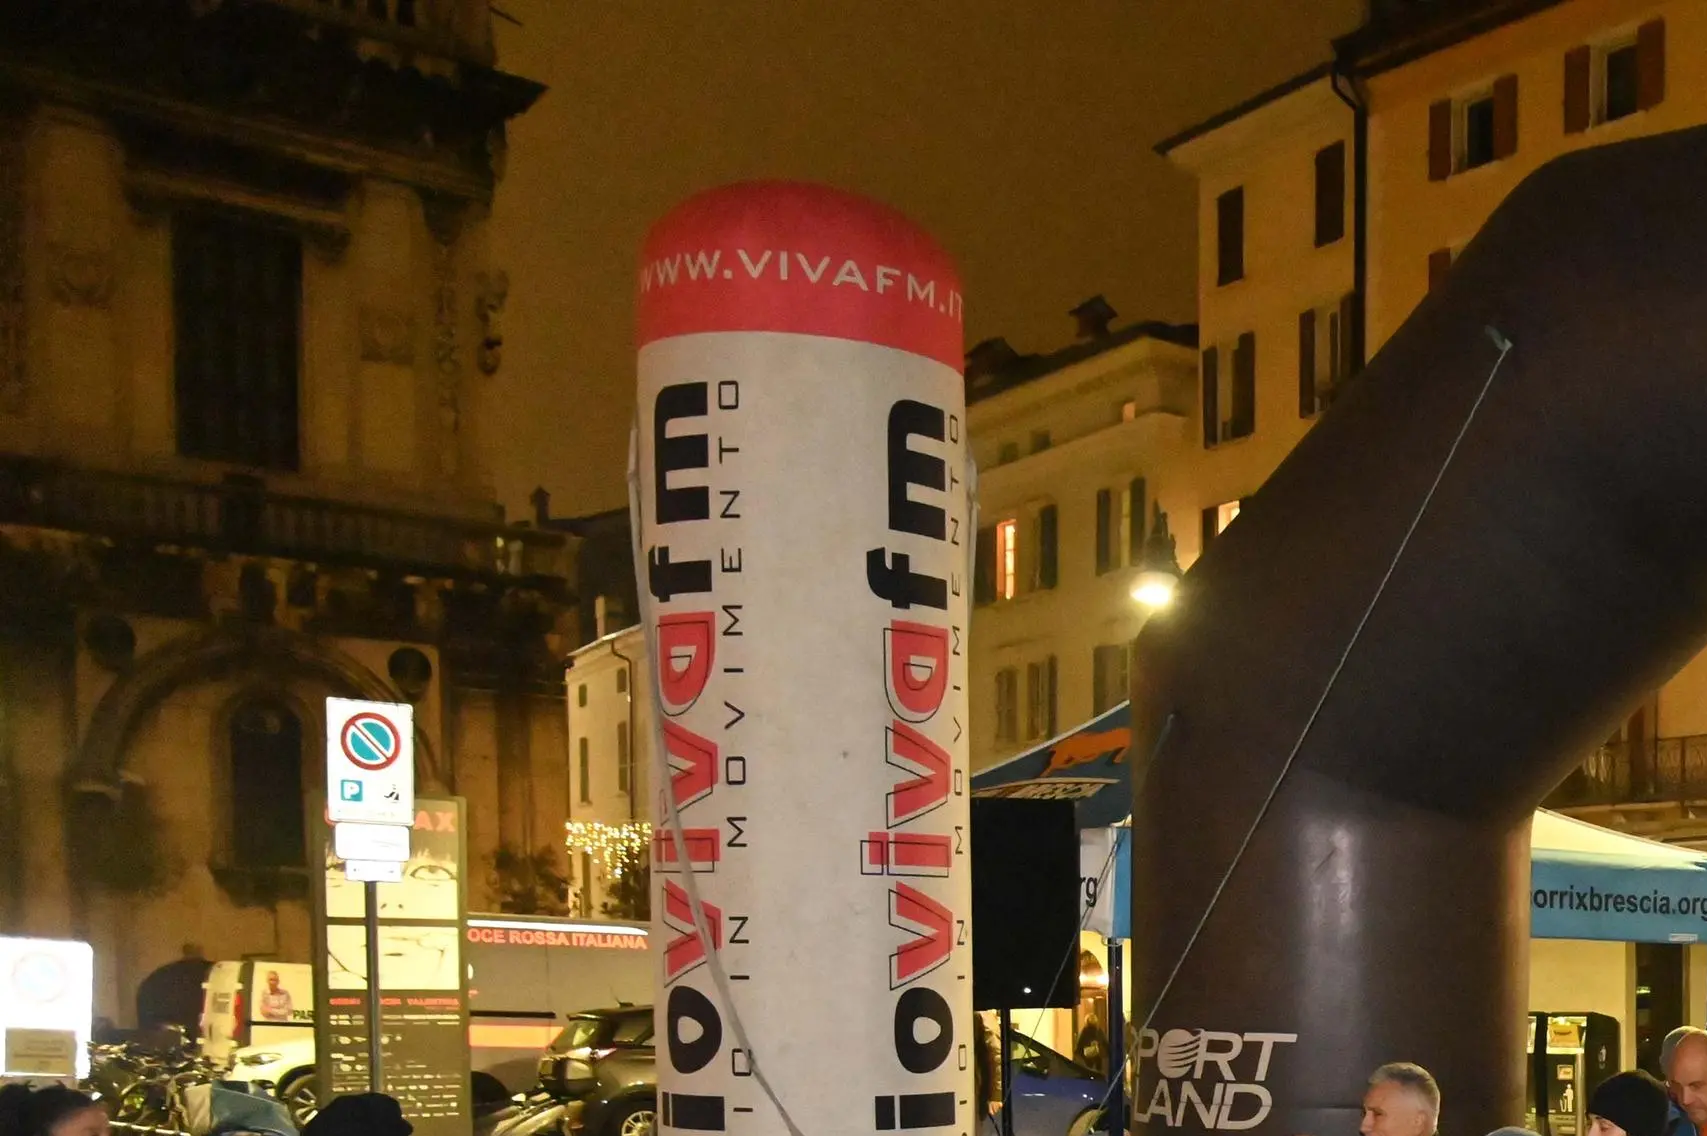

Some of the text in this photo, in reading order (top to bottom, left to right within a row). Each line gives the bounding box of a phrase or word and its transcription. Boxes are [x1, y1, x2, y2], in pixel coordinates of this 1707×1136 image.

[509, 930, 570, 947] ROSSA
[571, 932, 648, 950] ITALIANA
[1134, 1078, 1273, 1130] LAND
